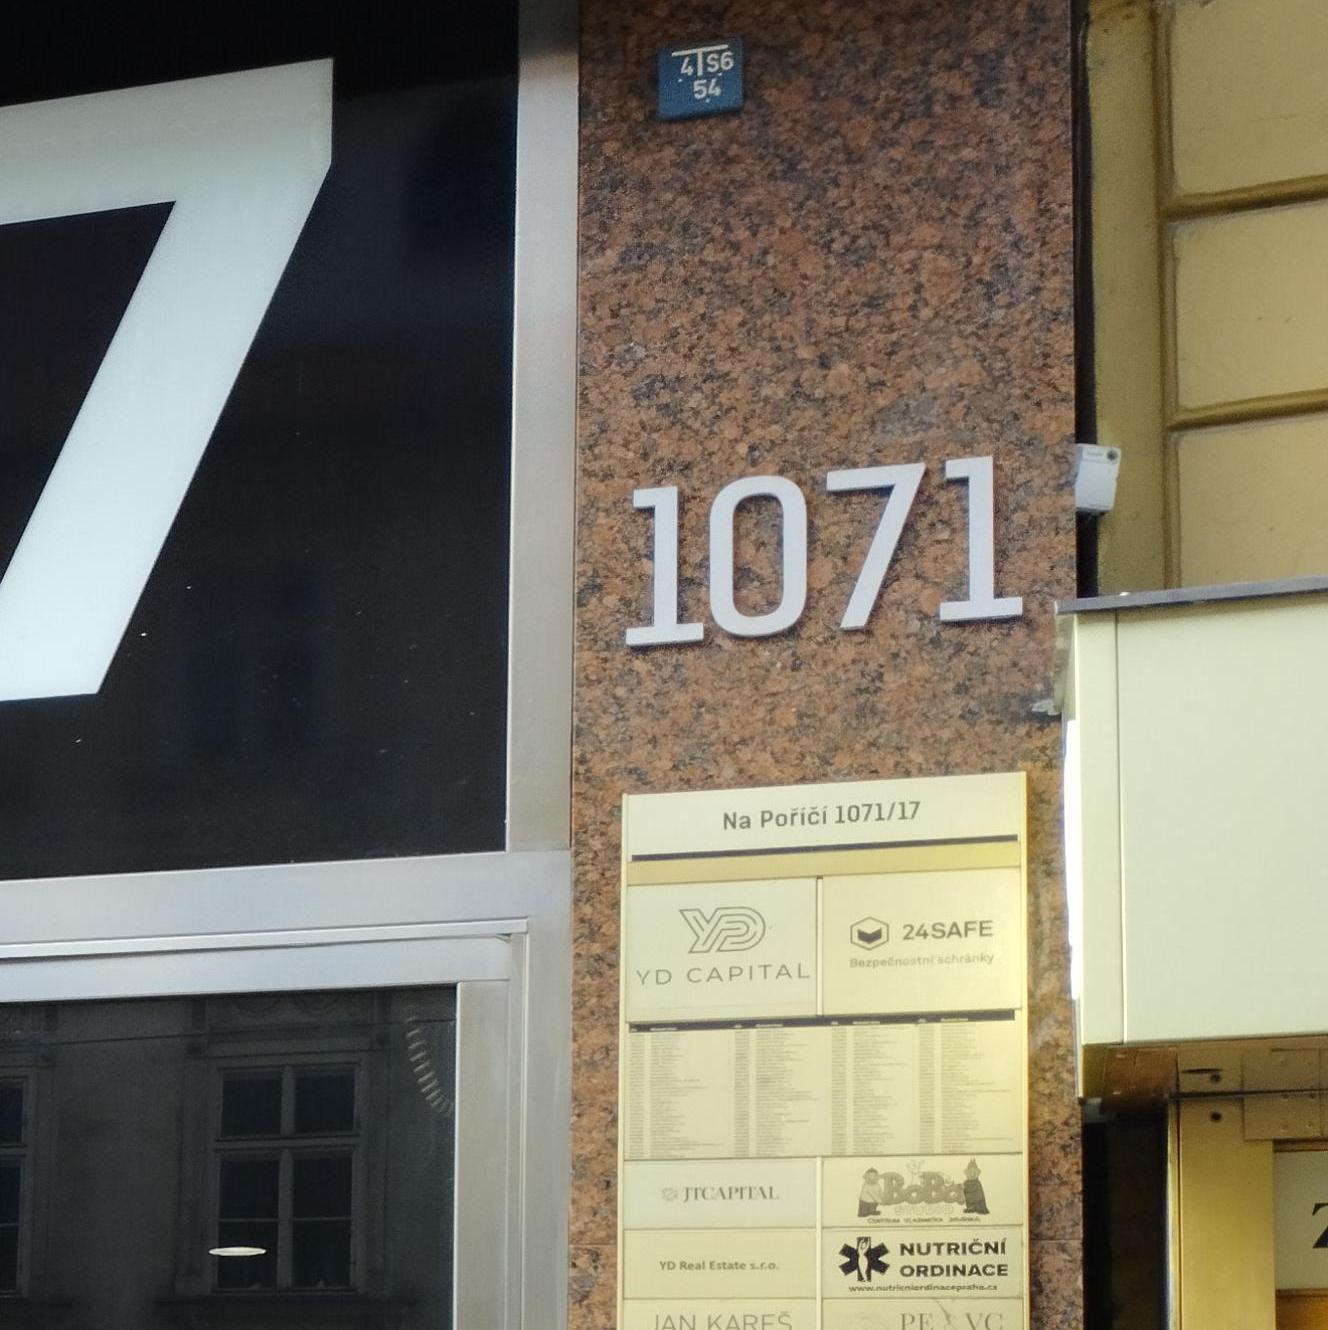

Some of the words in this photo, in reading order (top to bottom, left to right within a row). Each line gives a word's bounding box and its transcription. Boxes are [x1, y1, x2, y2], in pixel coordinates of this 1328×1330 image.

[693, 78, 721, 99] 54
[625, 456, 1024, 647] 1071
[723, 811, 752, 831] Na
[760, 805, 828, 829] Poříčí
[834, 800, 921, 824] 1071/17
[902, 920, 994, 941] 24SAFE
[636, 969, 673, 986] YD
[685, 963, 811, 984] CAPITAL
[899, 1237, 1007, 1256] NUTRIČNÍ
[659, 1261, 676, 1271] YD
[679, 1260, 706, 1271] Real
[709, 1260, 746, 1271] Estate
[749, 1261, 779, 1271] s.r.o.
[899, 1264, 1009, 1278] ORDINACE
